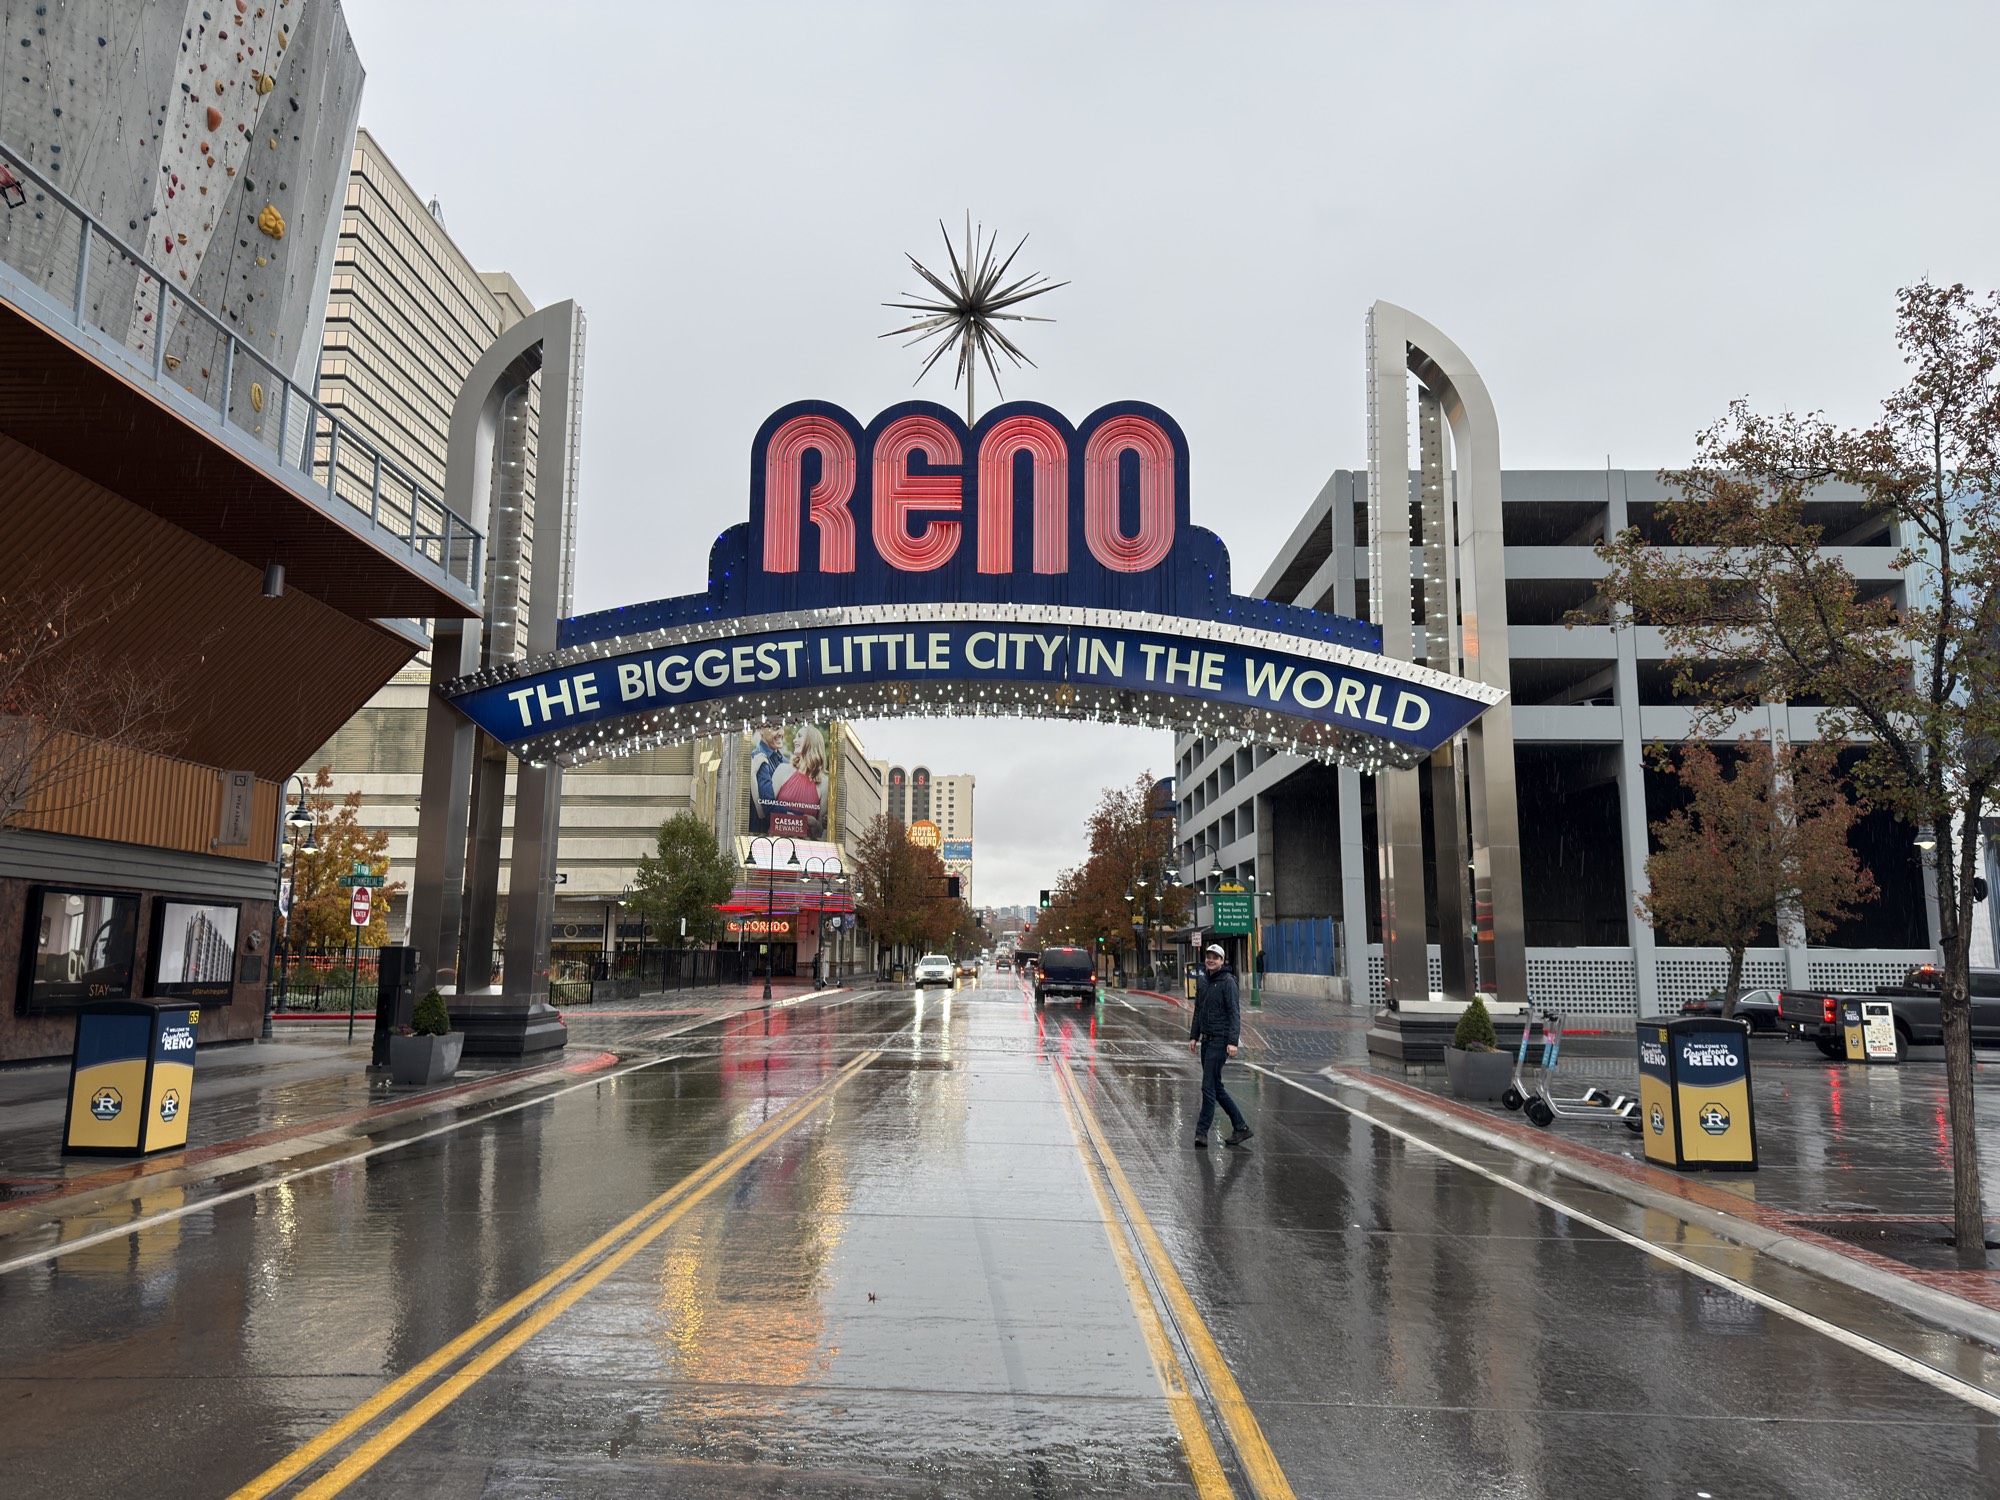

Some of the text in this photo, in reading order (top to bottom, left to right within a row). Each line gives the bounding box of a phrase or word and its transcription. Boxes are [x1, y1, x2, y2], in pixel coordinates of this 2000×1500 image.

[763, 414, 1176, 574] RENO
[508, 631, 1431, 731] THE BIGGEST LITTLE CITY IN THE WORLD
[757, 798, 821, 810] CAESARS.COM/MYREWARDS
[774, 817, 804, 827] CAESARS
[774, 825, 804, 833] REWARDS
[912, 826, 937, 837] HOTEL
[89, 984, 110, 997] STAY
[190, 1012, 199, 1023] 65
[164, 1037, 193, 1050] RENO
[1683, 1047, 1729, 1059] Downtown
[1644, 1053, 1666, 1066] RENO
[1689, 1054, 1738, 1066] RENO
[97, 1098, 115, 1111] R
[164, 1099, 175, 1113] R
[1653, 1112, 1662, 1126] R
[1706, 1113, 1724, 1125] R
